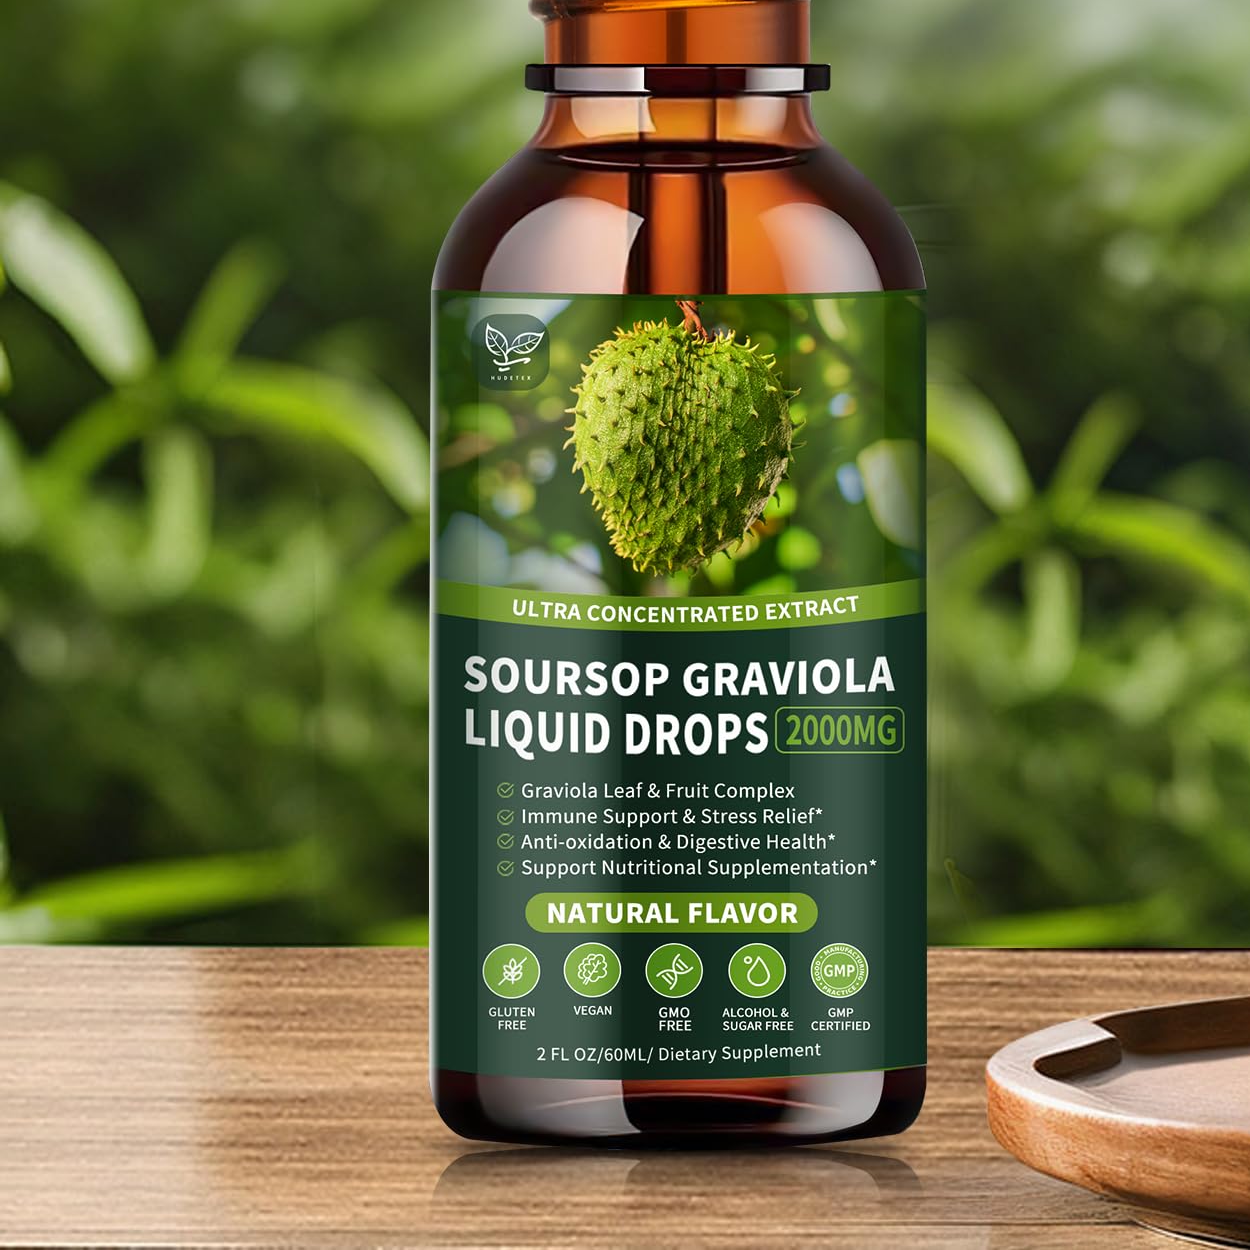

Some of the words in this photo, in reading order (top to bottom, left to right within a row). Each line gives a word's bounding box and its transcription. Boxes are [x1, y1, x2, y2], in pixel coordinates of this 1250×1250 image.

[512, 599, 582, 621] ULTRA
[587, 604, 759, 623] CONCENTRATED
[765, 595, 859, 620] EXTRACT
[464, 655, 669, 697] SOURSOP
[683, 656, 895, 697] GRAVIOLA
[466, 708, 610, 761] LIQUID
[625, 712, 769, 756] DROPS
[786, 714, 897, 747] 2000MG
[521, 781, 598, 799] Graviola
[604, 781, 644, 799] Leaf
[647, 782, 661, 799] &
[666, 782, 709, 799] Fruit
[714, 781, 795, 803] Complex
[522, 808, 598, 825] Immune
[603, 808, 678, 828] Support
[682, 808, 696, 824] &
[701, 808, 757, 824] Stress
[520, 833, 652, 850] Anti-oxidation
[658, 833, 672, 850] &
[677, 833, 761, 854] Digestive
[521, 859, 597, 880] Support
[602, 858, 702, 876] Nutritional
[547, 902, 679, 924] NATURAL
[688, 902, 798, 924] FLAVOR
[814, 960, 822, 981] GOOD
[823, 946, 865, 981] MANUFACTURING
[823, 963, 856, 978] GMP
[822, 984, 857, 996] PRACTICE
[488, 1006, 536, 1018] GLUTEN
[573, 1005, 613, 1016] VEGAN
[658, 1006, 690, 1019] GMO
[722, 1007, 778, 1018] ALCOHOL
[780, 1007, 790, 1018] &
[827, 1007, 854, 1018] GMP
[497, 1019, 527, 1031] FREE
[659, 1019, 692, 1032] FREE
[722, 1020, 763, 1031] SUGAR
[765, 1020, 794, 1031] FREE
[810, 1020, 871, 1031] CERTIFIED
[536, 1046, 547, 1062] 2
[551, 1046, 570, 1062] FL
[658, 1047, 717, 1064] Dietary
[721, 1042, 822, 1063] Supplement
